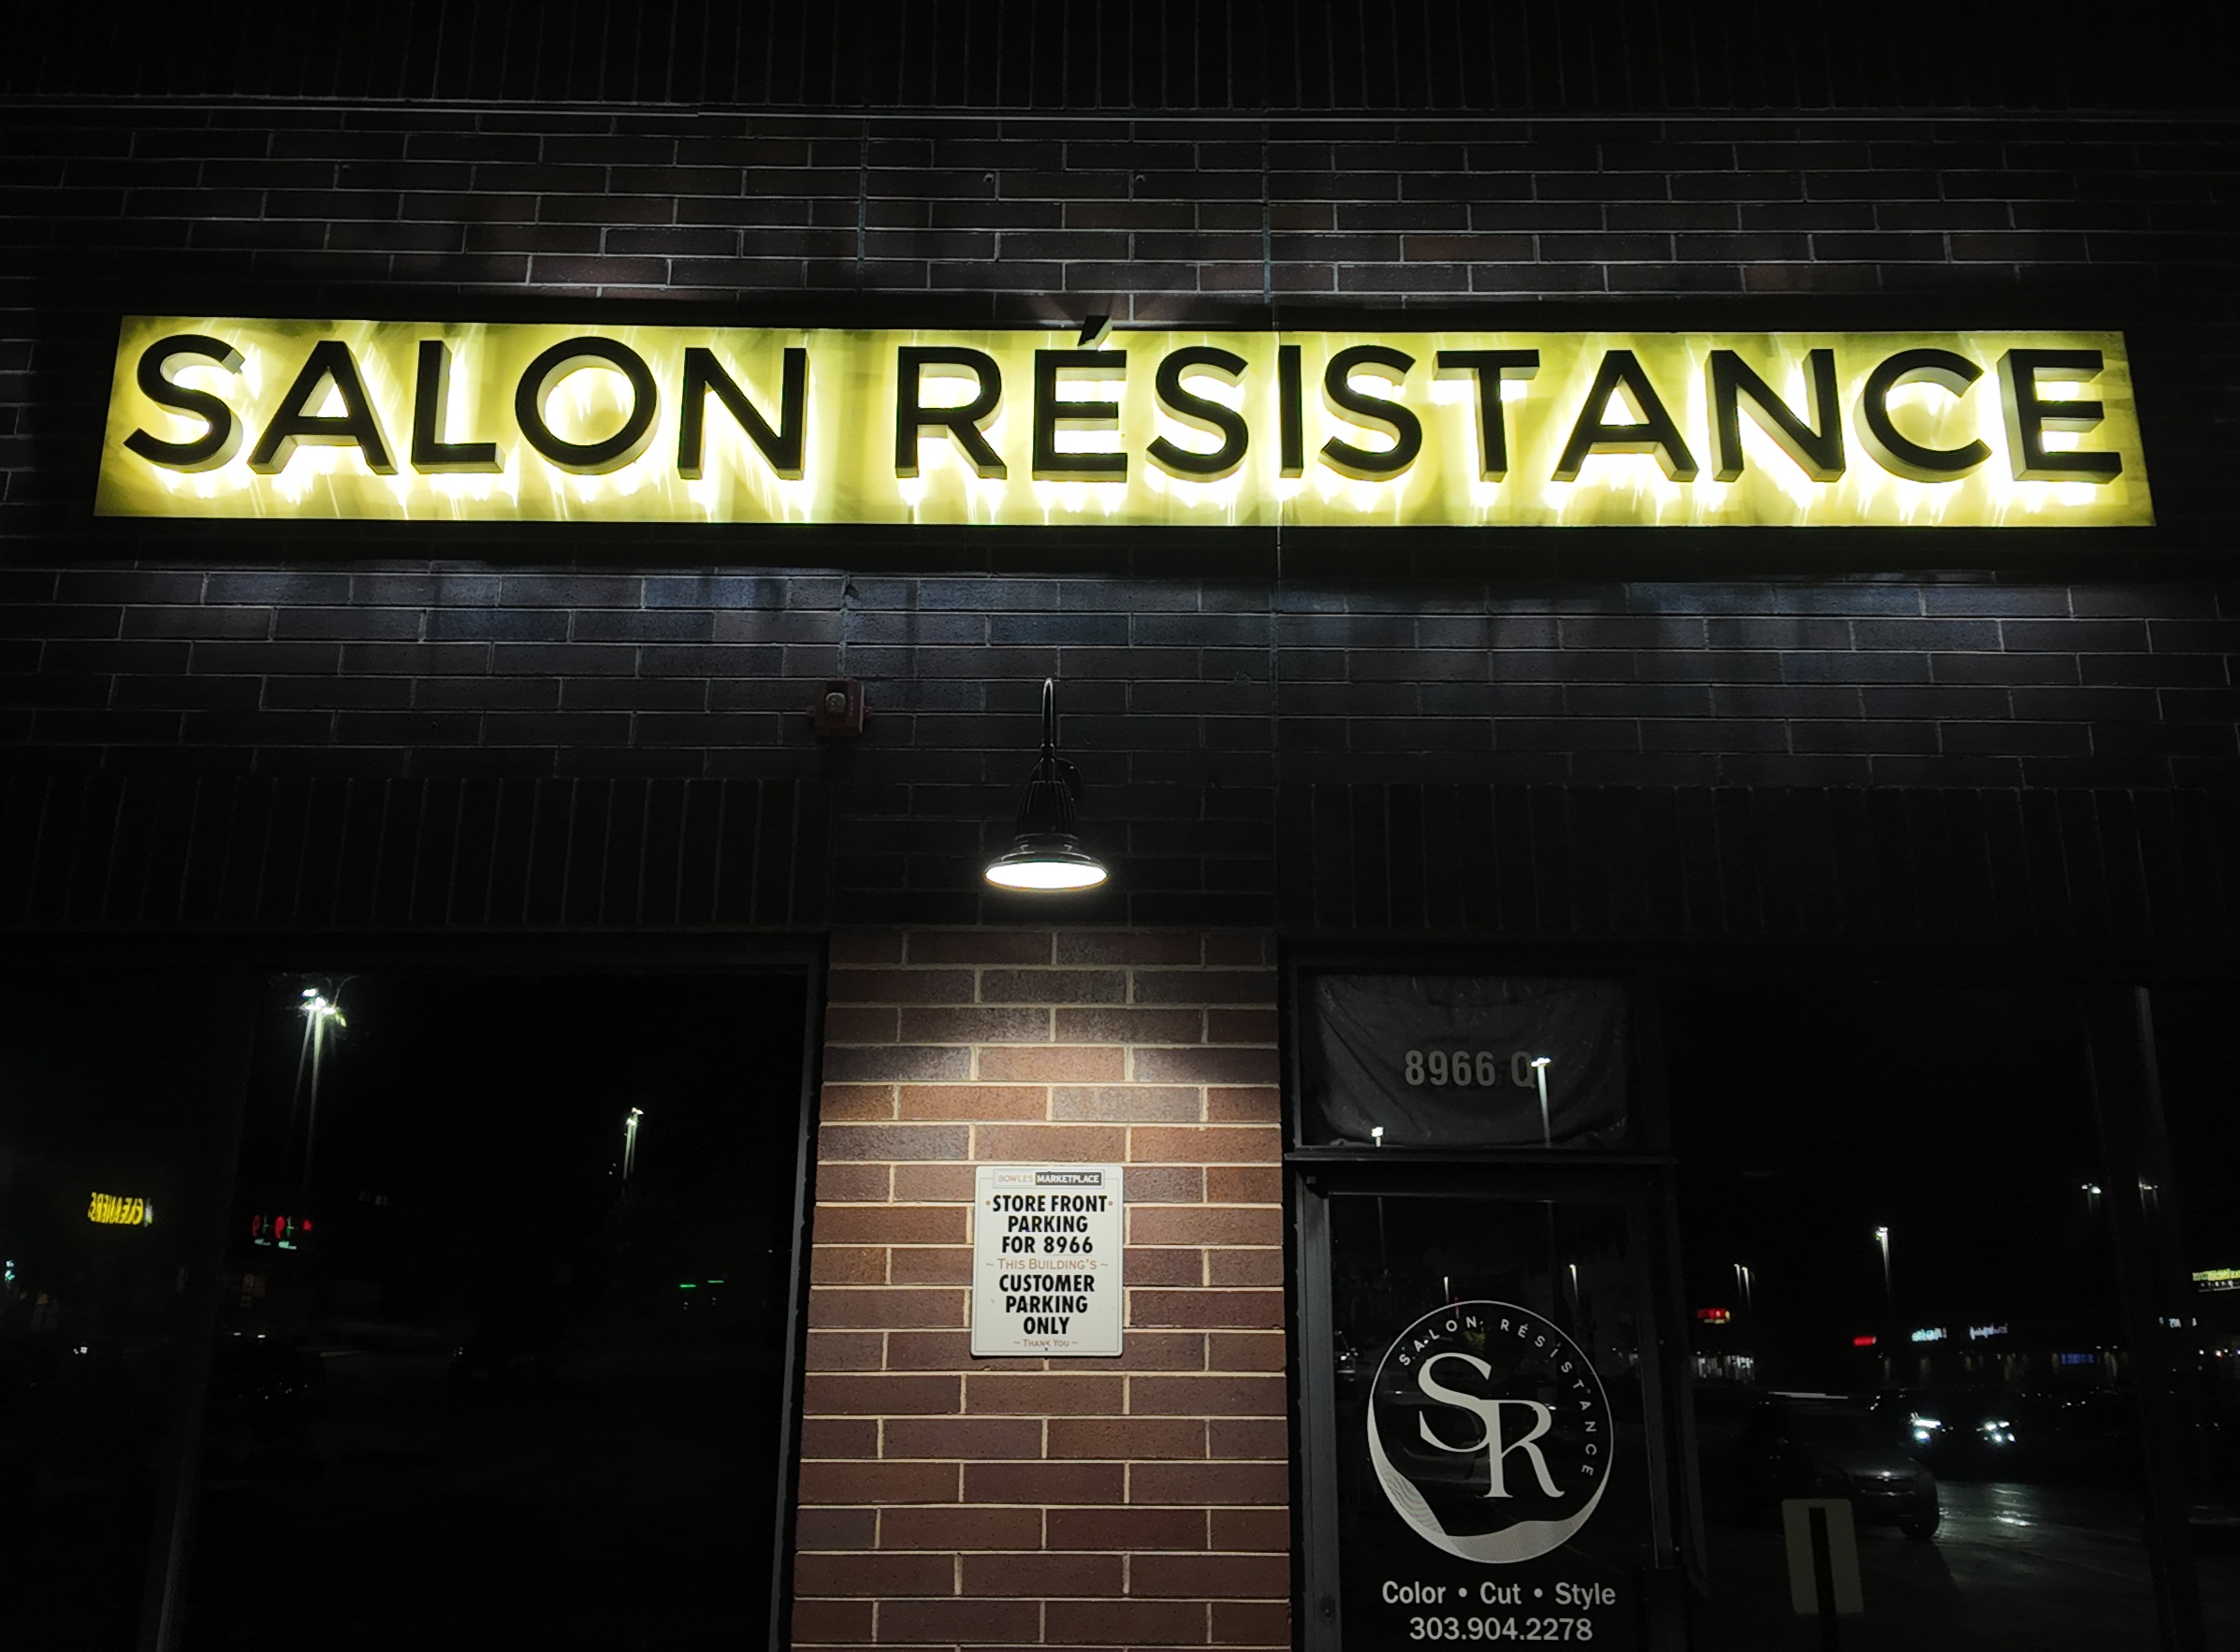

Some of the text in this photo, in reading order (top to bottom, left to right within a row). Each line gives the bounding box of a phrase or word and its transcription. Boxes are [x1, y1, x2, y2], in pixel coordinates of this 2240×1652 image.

[123, 316, 2122, 485] SALON RÉSISTANCE
[1405, 1050, 1536, 1089] 8966 Q
[997, 1174, 1100, 1184] BOWLES MARKETPLACE
[993, 1195, 1108, 1212] STORE FRONT
[1008, 1215, 1088, 1233] PARKING
[1002, 1236, 1093, 1253] FOR 8966
[999, 1274, 1095, 1292] CUSTOMER
[1006, 1296, 1088, 1313] PARKING
[1024, 1316, 1070, 1335] ONLY
[1398, 1315, 1597, 1476] SALON RÉSISTANCE
[1418, 1352, 1564, 1499] SR
[1382, 1581, 1616, 1611] Color Cut Style
[1408, 1616, 1593, 1641] 303.904.2278
